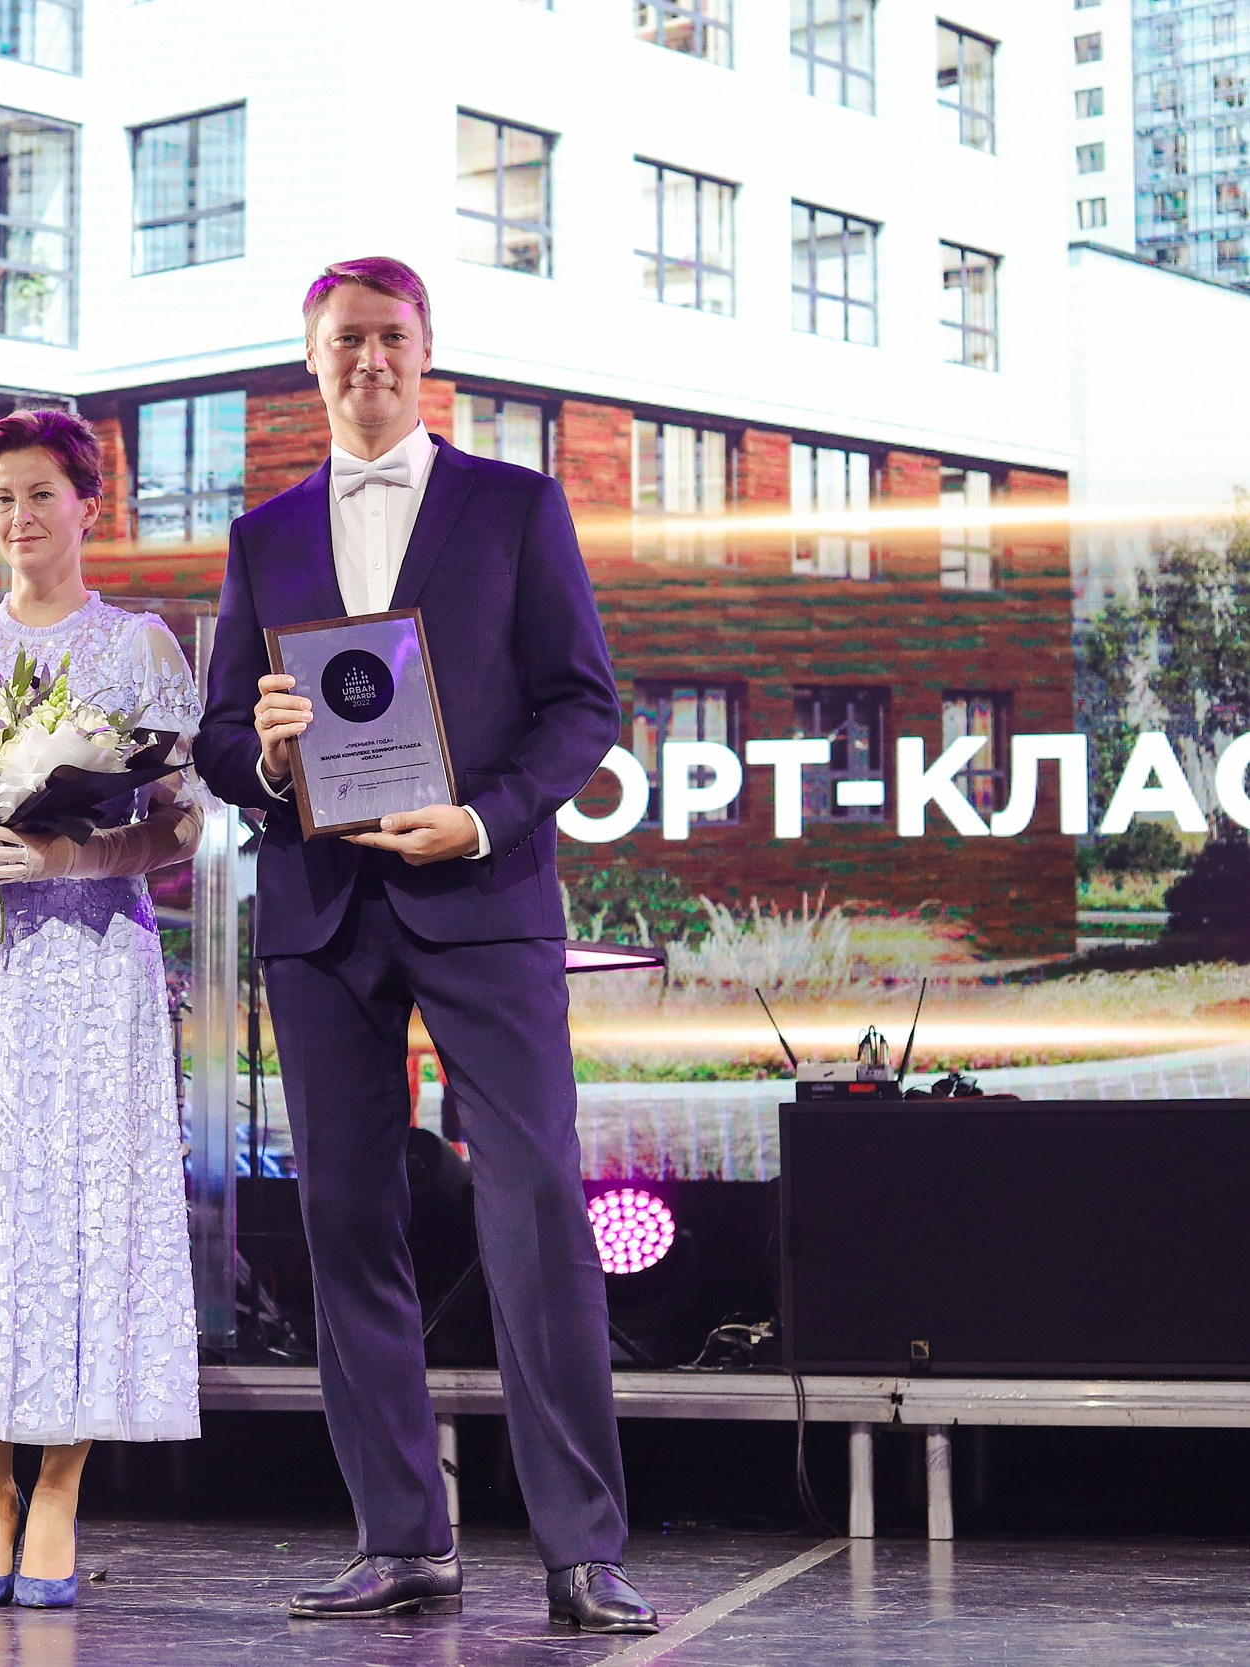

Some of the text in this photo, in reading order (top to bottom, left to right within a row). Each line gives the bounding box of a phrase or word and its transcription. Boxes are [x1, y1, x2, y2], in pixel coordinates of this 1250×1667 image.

[342, 684, 375, 695] URBAN
[344, 692, 376, 702] AWARDS
[352, 699, 370, 707] 2022
[345, 741, 375, 749] «ПРЕМЬЕРА
[320, 743, 421, 761] ЖИЛОЙ КОМПЛЕКС КОМФОРТ-КЛАССА
